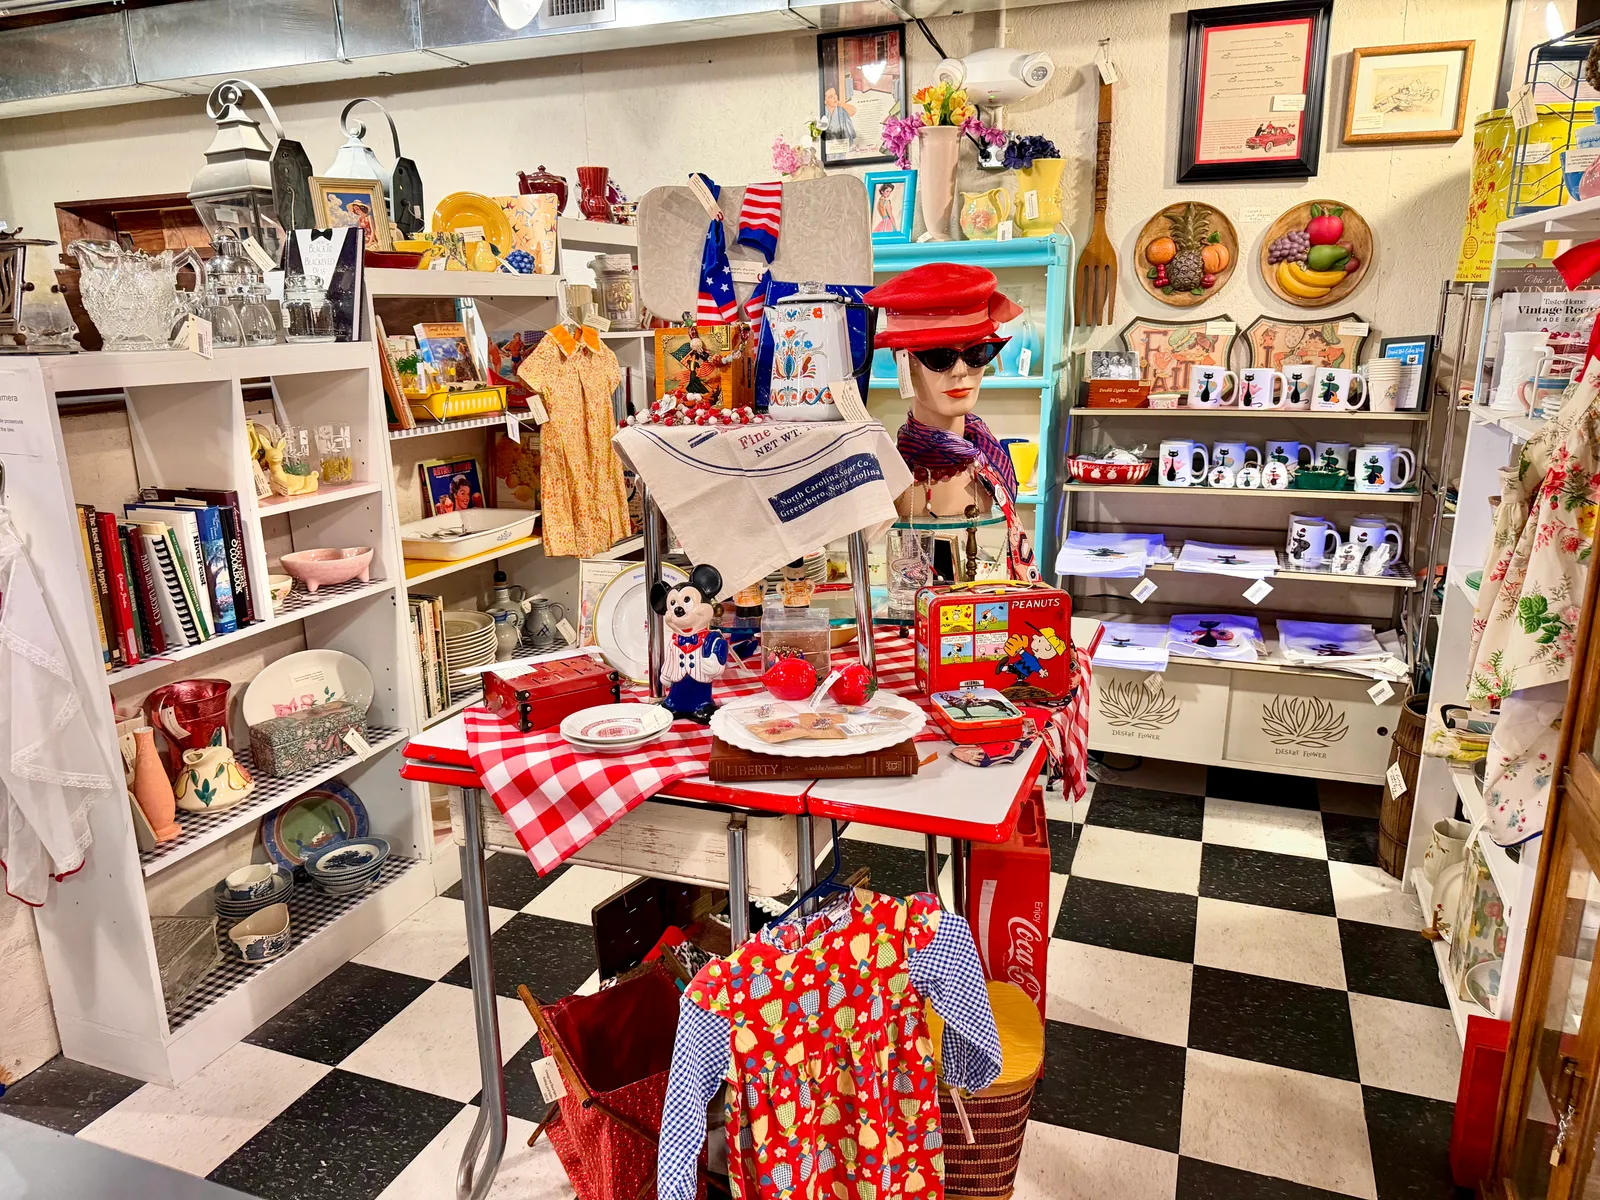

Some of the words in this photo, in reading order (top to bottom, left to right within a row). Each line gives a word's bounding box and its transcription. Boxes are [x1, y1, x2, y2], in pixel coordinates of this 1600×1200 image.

[1518, 305, 1562, 316] Vintage
[738, 429, 771, 450] Fine
[754, 439, 778, 457] NET
[780, 429, 802, 443] WT.
[780, 490, 804, 507] North
[805, 473, 839, 494] Carolina
[839, 464, 856, 477] Sugar
[857, 459, 871, 468] Co.
[780, 490, 828, 518] Greensboro,
[829, 478, 849, 493] North
[849, 469, 880, 482] Carolina
[88, 512, 96, 527] The
[91, 527, 99, 543] Best
[94, 543, 101, 552] of
[95, 552, 103, 568] Bon
[140, 553, 148, 573] MAIN
[193, 535, 206, 586] RiverFeast
[229, 547, 243, 595] COOKBOOK
[1012, 598, 1060, 609] PEANUTS
[1111, 729, 1135, 737] DESERT
[1137, 732, 1160, 741] FLOWER
[1275, 747, 1299, 756] DESERT
[1302, 750, 1327, 759] FLOWER
[727, 764, 778, 776] LIBERTY
[1033, 901, 1043, 923] Enjoy
